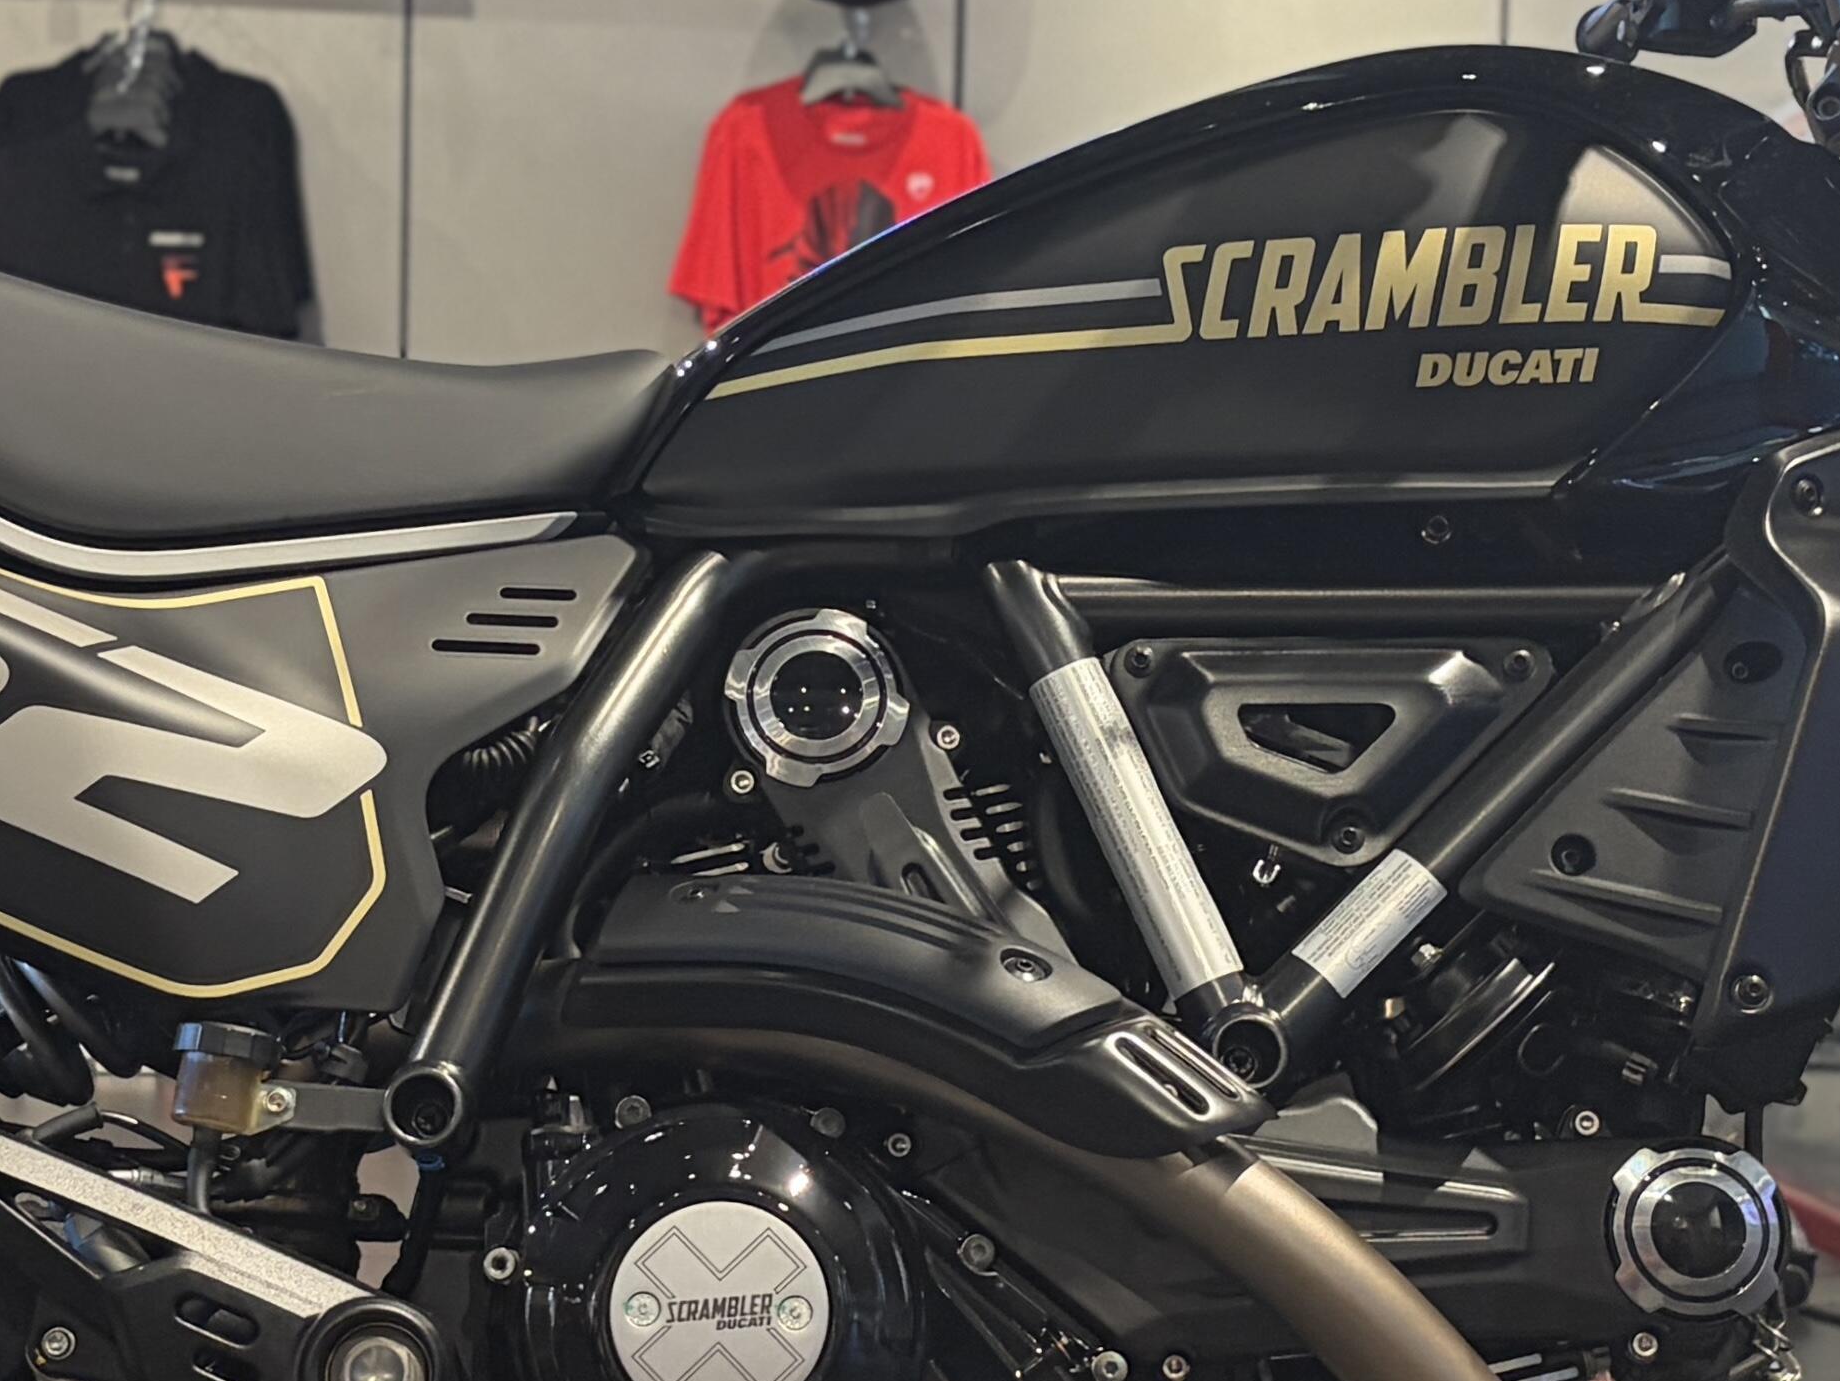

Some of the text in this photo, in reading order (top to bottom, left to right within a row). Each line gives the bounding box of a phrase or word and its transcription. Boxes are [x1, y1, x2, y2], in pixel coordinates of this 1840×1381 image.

[1161, 222, 1659, 342] SCRAMBLER
[1415, 346, 1601, 390] DUCATI
[666, 1293, 773, 1323] SCRAMBLER
[716, 1317, 772, 1330] DUCATI
